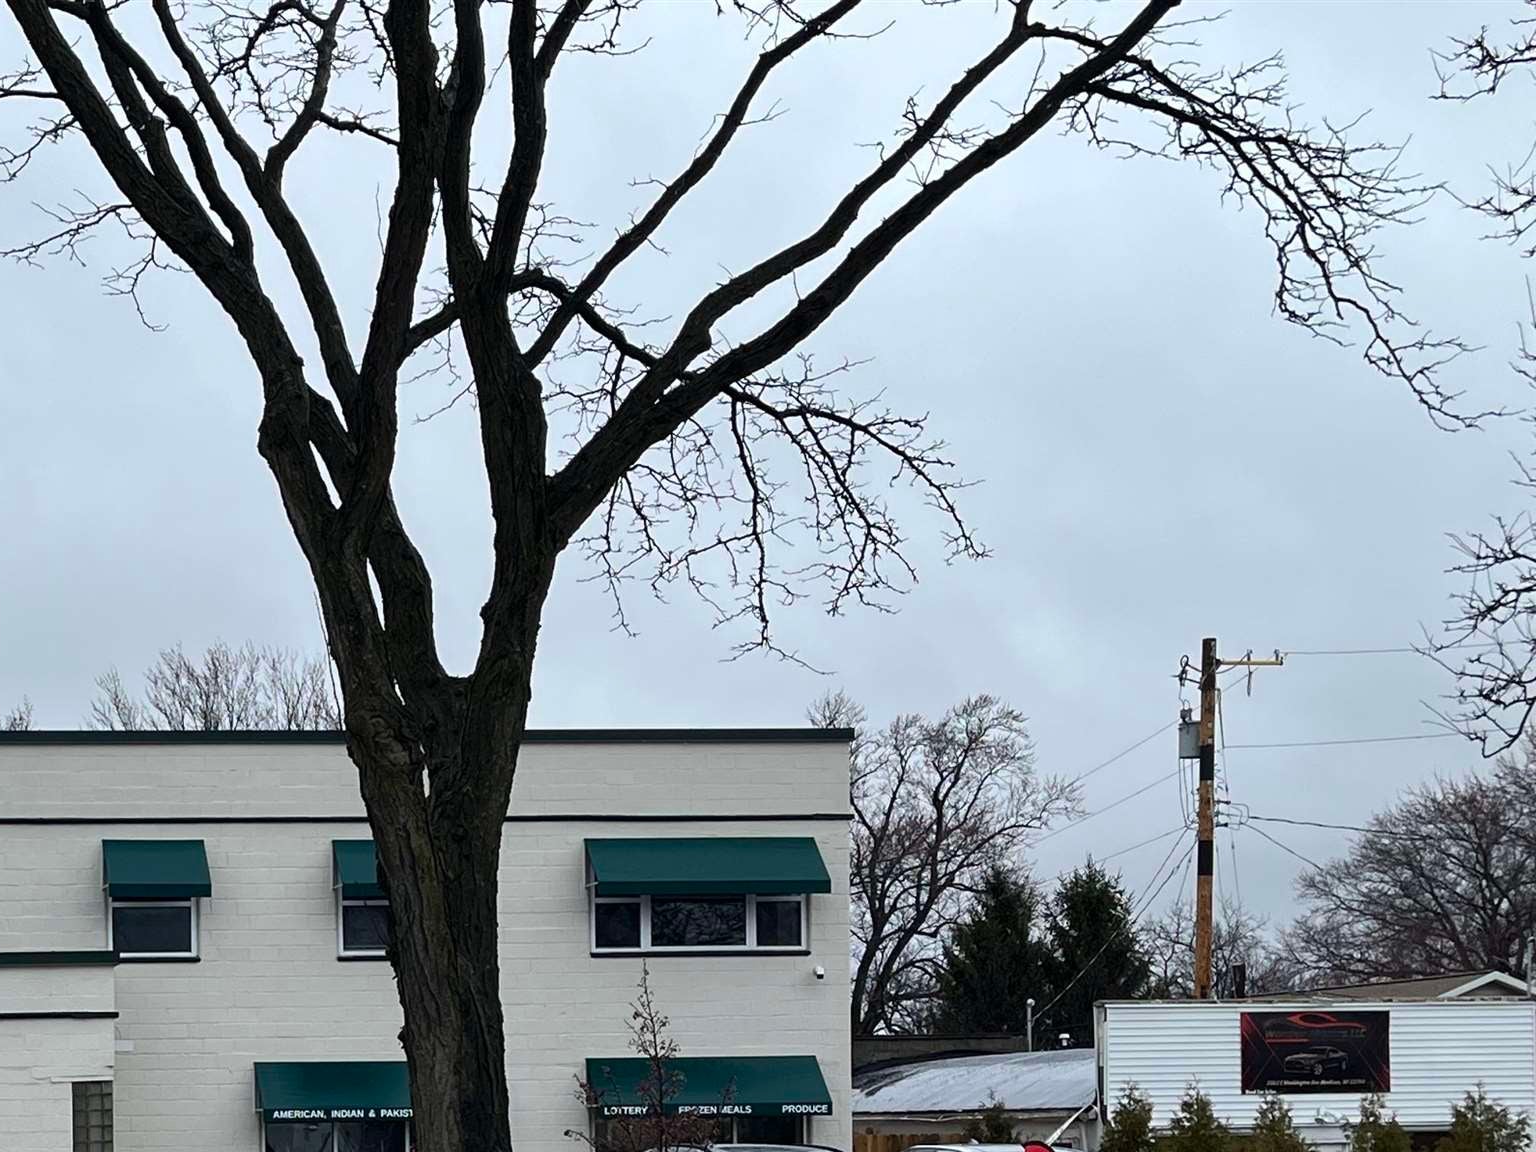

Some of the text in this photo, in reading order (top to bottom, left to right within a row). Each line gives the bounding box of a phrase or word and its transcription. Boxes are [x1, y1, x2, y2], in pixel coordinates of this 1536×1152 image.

[273, 1109, 414, 1119] AMERICAN, INDIAN & PAKIST
[604, 1106, 648, 1115] LOTTERY
[782, 1104, 829, 1113] PRODUCE
